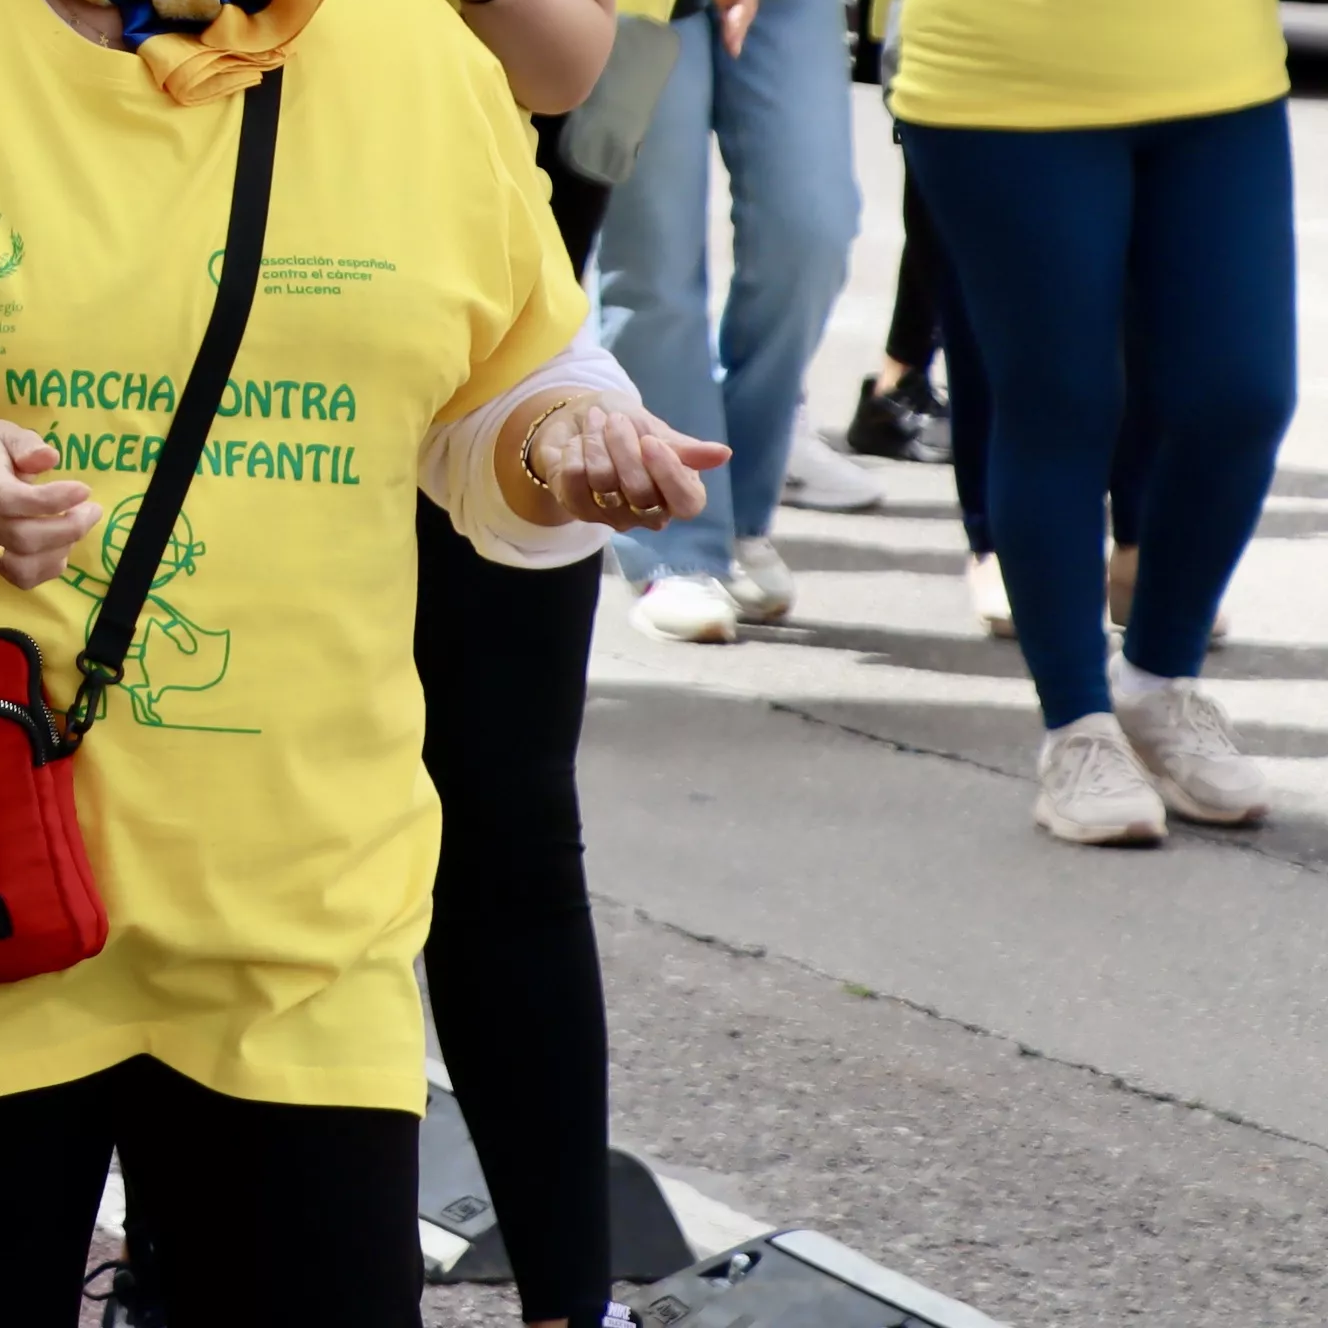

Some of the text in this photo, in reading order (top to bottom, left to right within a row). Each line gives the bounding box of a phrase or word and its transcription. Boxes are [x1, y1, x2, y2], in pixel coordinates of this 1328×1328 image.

[261, 255, 397, 272] asociación española
[262, 269, 308, 279] contra
[311, 269, 323, 279] el
[264, 284, 341, 295] en Lucena
[5, 369, 176, 412] MARCHA
[216, 378, 356, 422] ONTRA
[195, 440, 360, 485] NFANTIL
